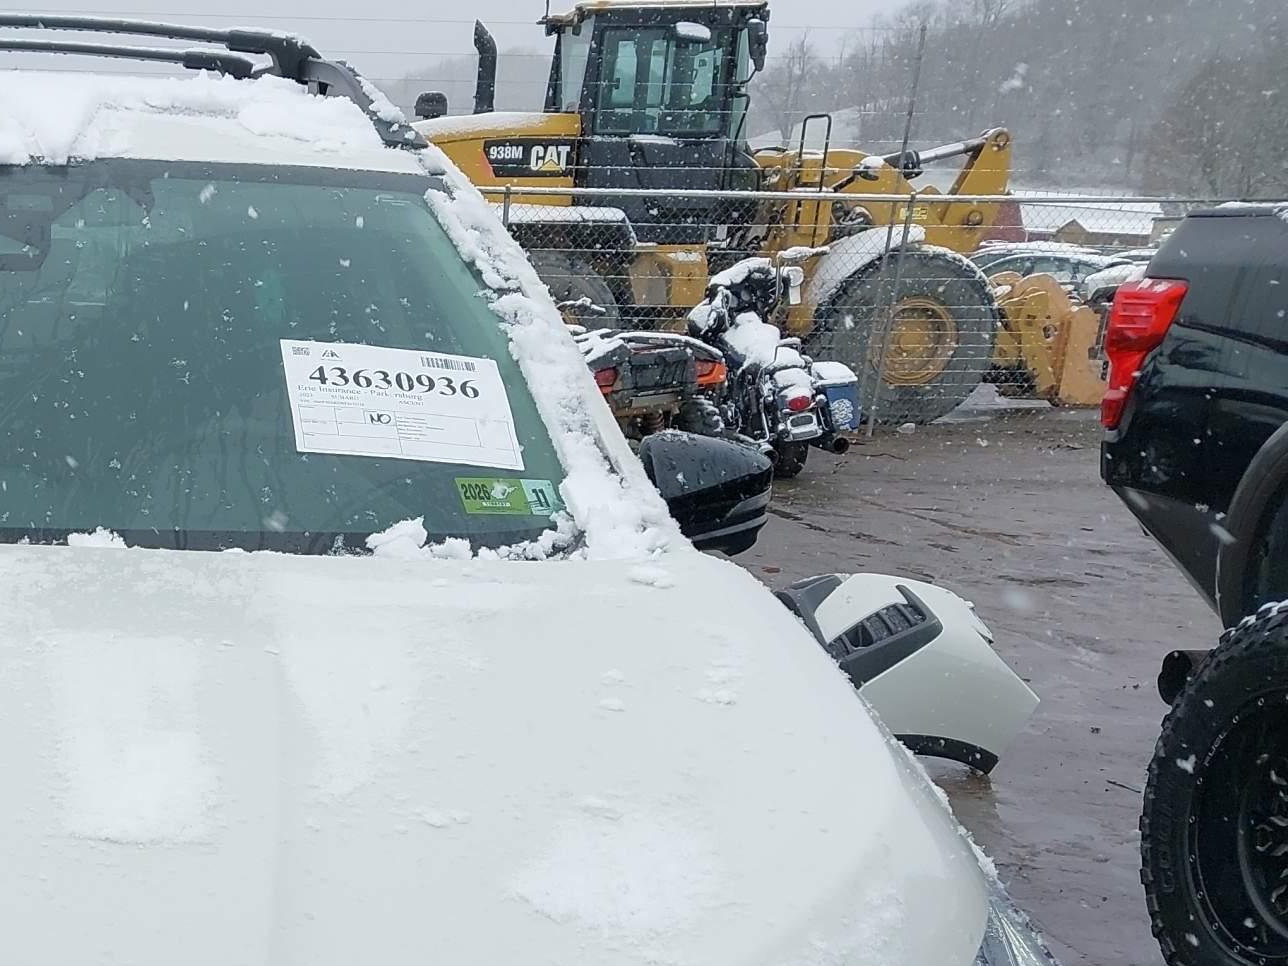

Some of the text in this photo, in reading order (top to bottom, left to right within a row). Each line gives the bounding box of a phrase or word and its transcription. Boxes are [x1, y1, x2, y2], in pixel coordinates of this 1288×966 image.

[489, 146, 571, 171] 938M CAT
[309, 365, 481, 399] 43630936
[319, 386, 361, 394] Insurance
[461, 483, 551, 507] 2026 11
